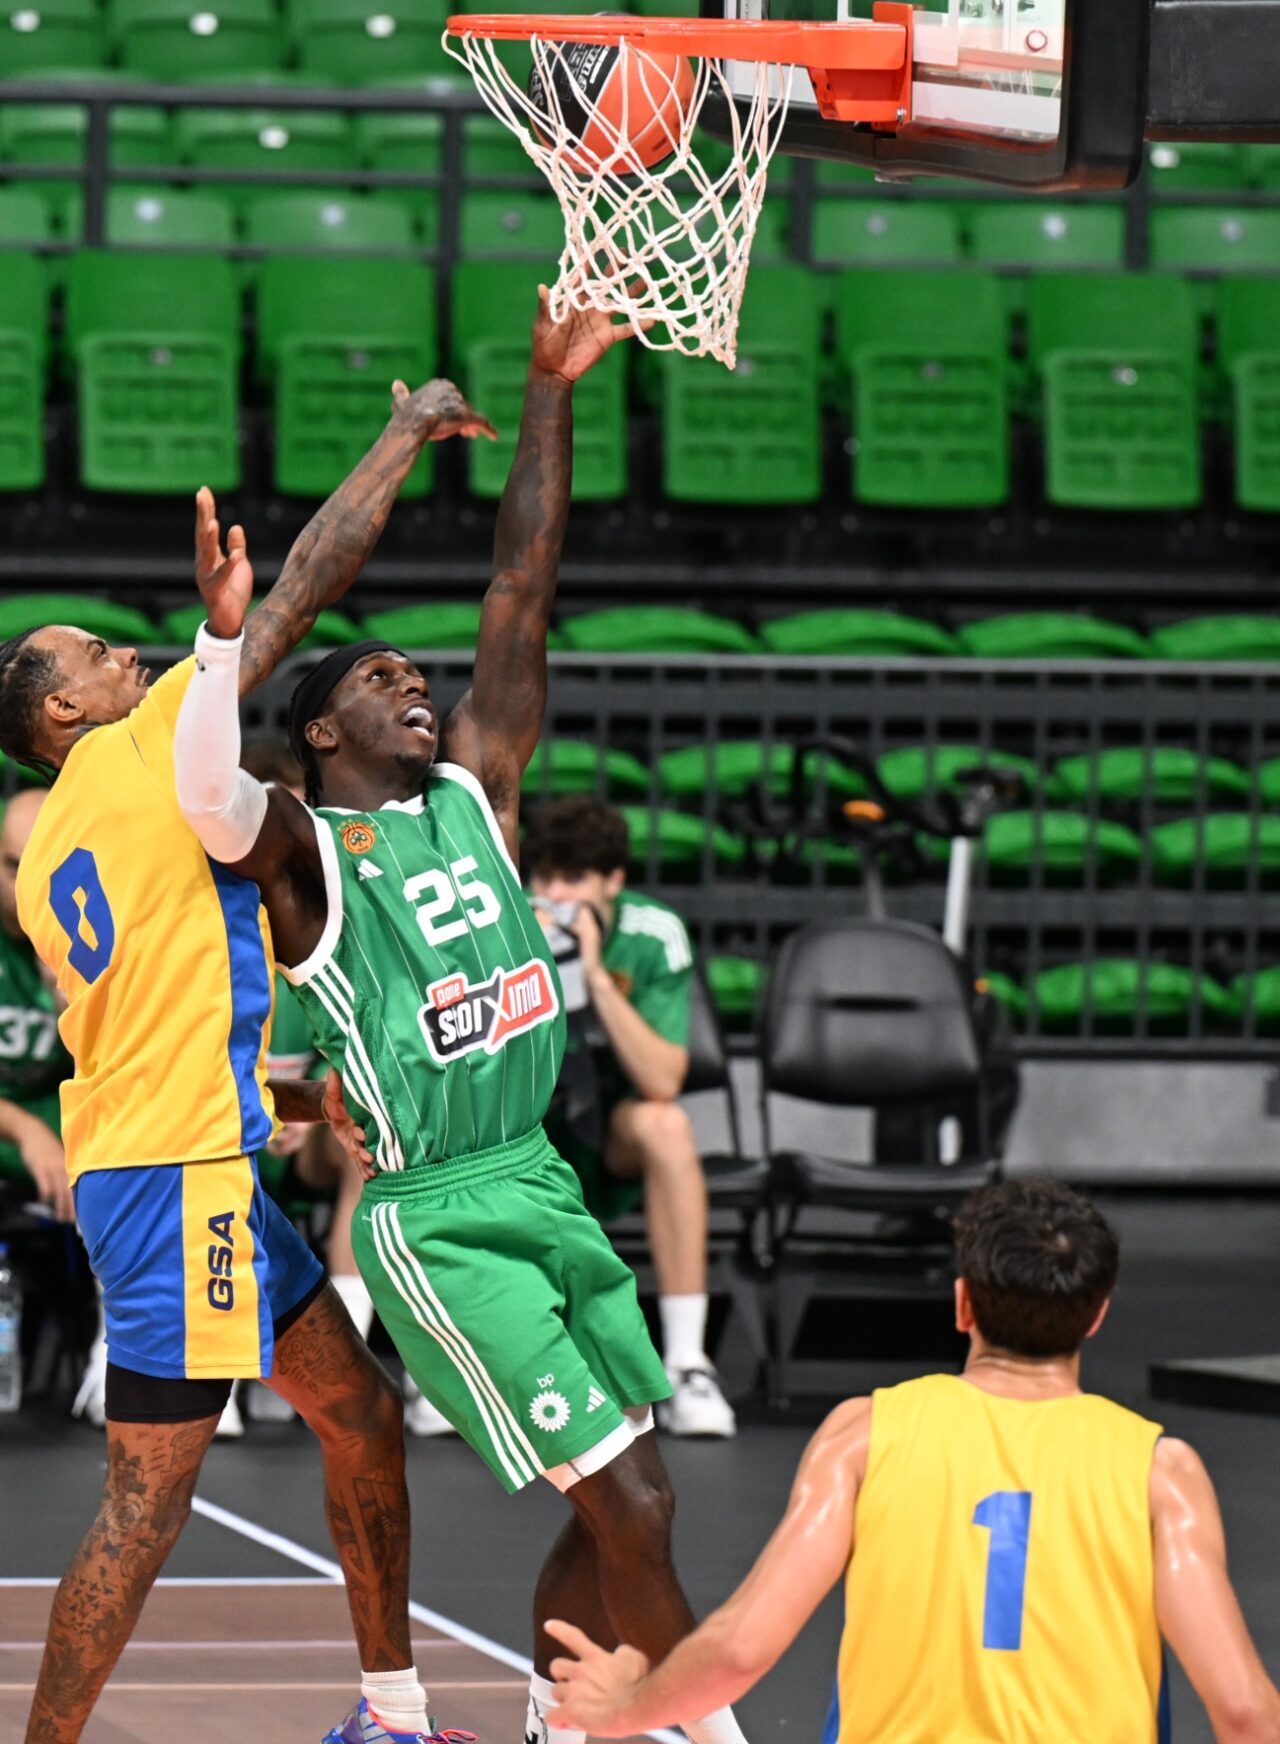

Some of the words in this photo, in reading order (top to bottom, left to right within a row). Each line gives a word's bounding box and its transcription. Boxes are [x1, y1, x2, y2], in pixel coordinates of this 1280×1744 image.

[49, 847, 115, 985] 0
[403, 855, 501, 947] 25
[207, 1210, 235, 1312] GSA
[535, 1373, 556, 1389] bp
[972, 1491, 1032, 1651] 1
